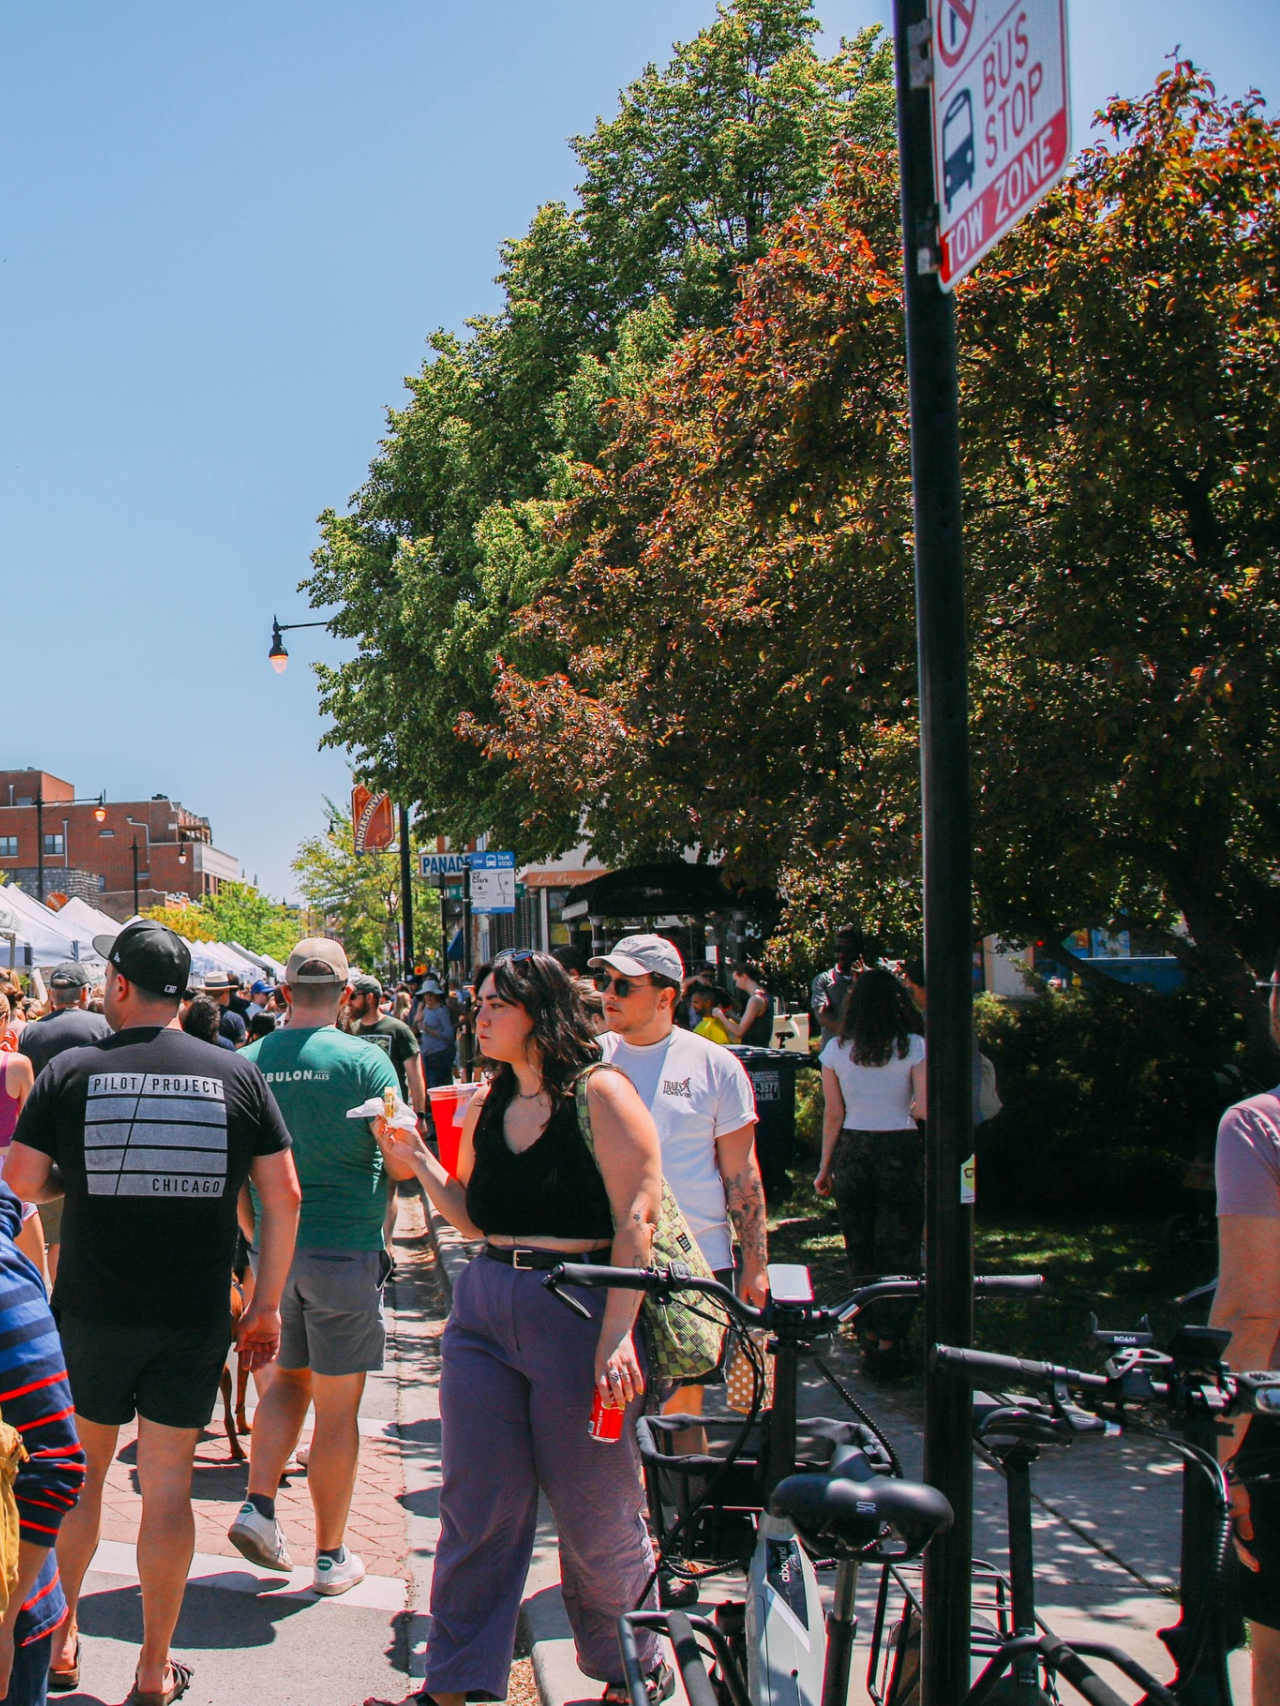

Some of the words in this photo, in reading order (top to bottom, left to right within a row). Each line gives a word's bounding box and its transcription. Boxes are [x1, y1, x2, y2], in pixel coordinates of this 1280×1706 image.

[983, 11, 1029, 109] BUS
[985, 62, 1043, 168] STOP
[945, 201, 984, 273] TOW
[994, 126, 1055, 225] ZONE
[355, 788, 389, 853] ANDERSONVILL
[93, 1077, 137, 1092] PILOT
[152, 1078, 219, 1095] PROJECT
[152, 1178, 220, 1193] CHICAGO
